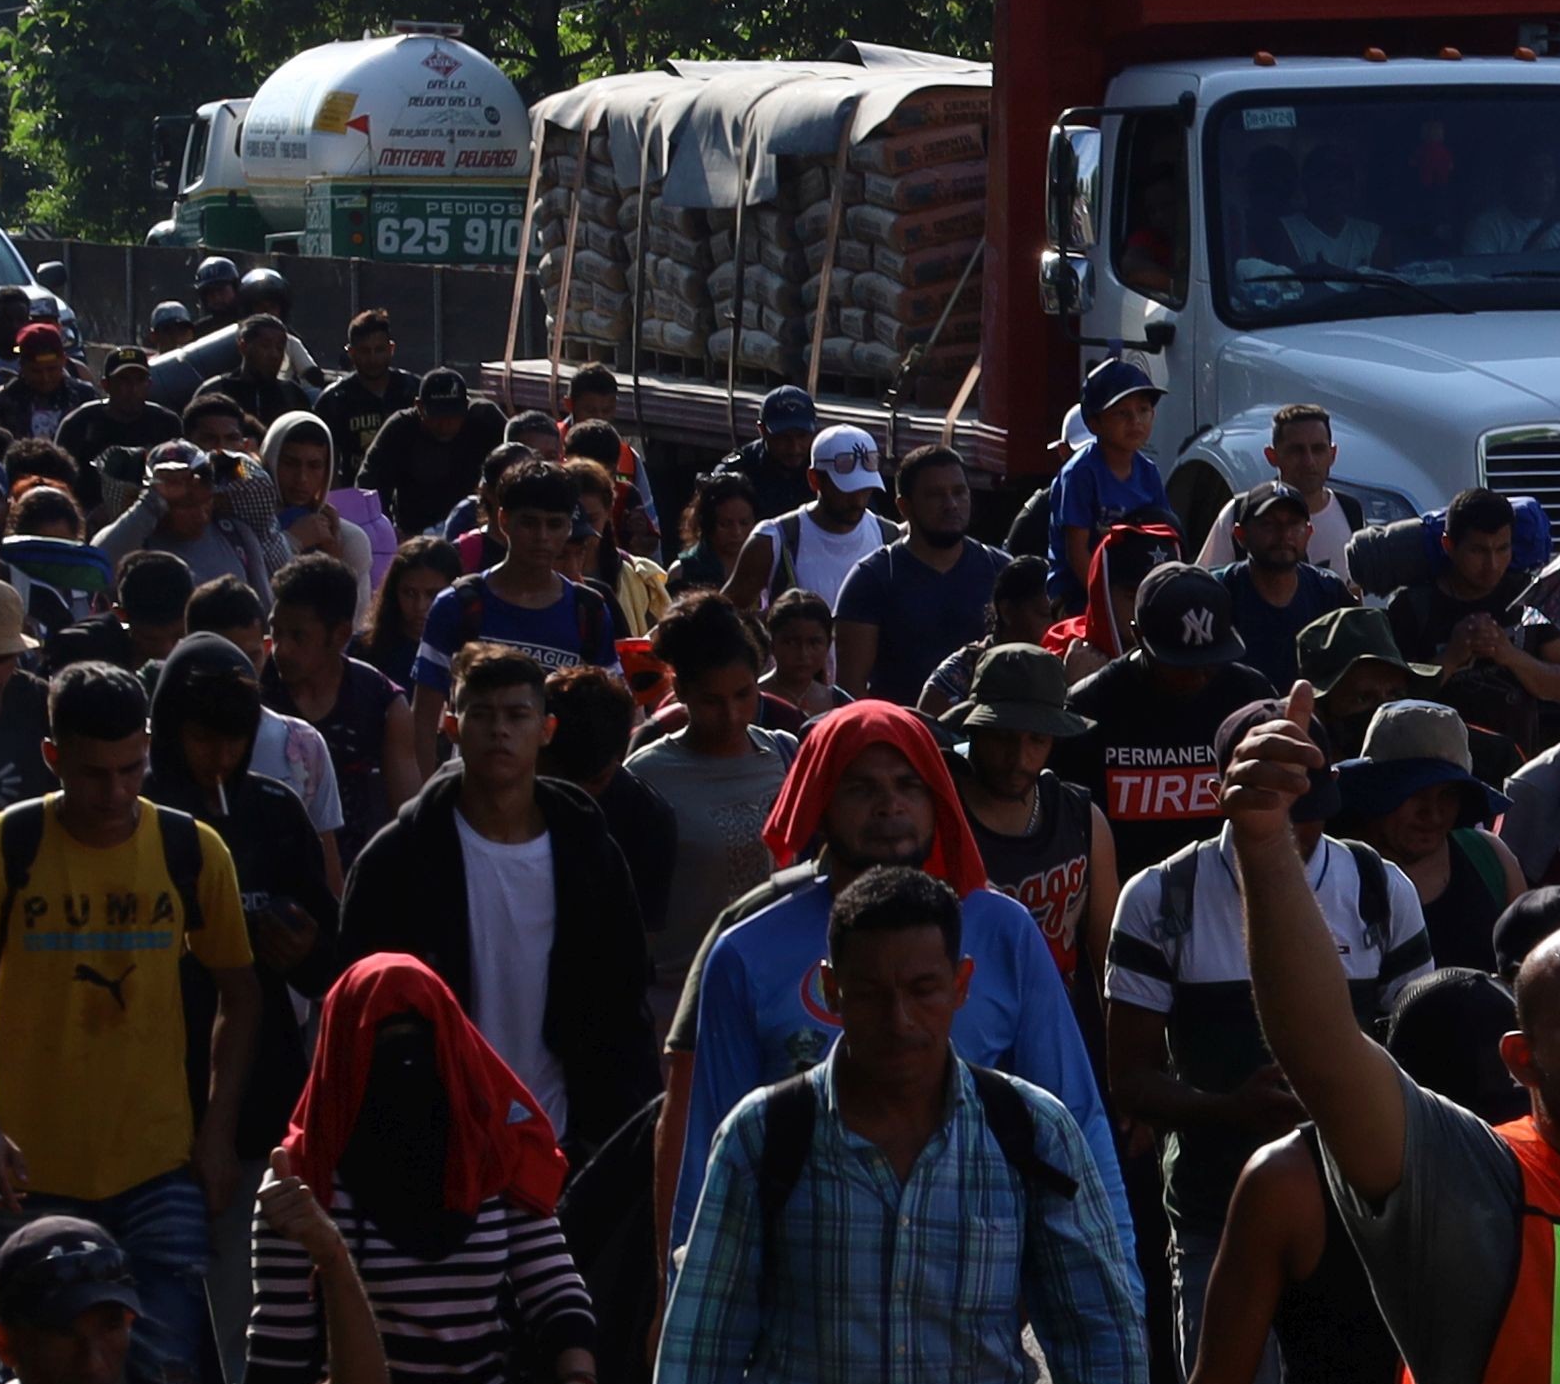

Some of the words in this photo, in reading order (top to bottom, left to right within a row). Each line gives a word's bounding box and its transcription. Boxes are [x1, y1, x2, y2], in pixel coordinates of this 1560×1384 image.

[426, 80, 449, 90] GAS
[379, 148, 446, 167] MATERIAL
[454, 149, 518, 168] PELIGROSO
[425, 201, 523, 215] PEDIDOS
[377, 217, 451, 254] 625
[1180, 605, 1214, 645] NY
[23, 890, 175, 928] PUMA
